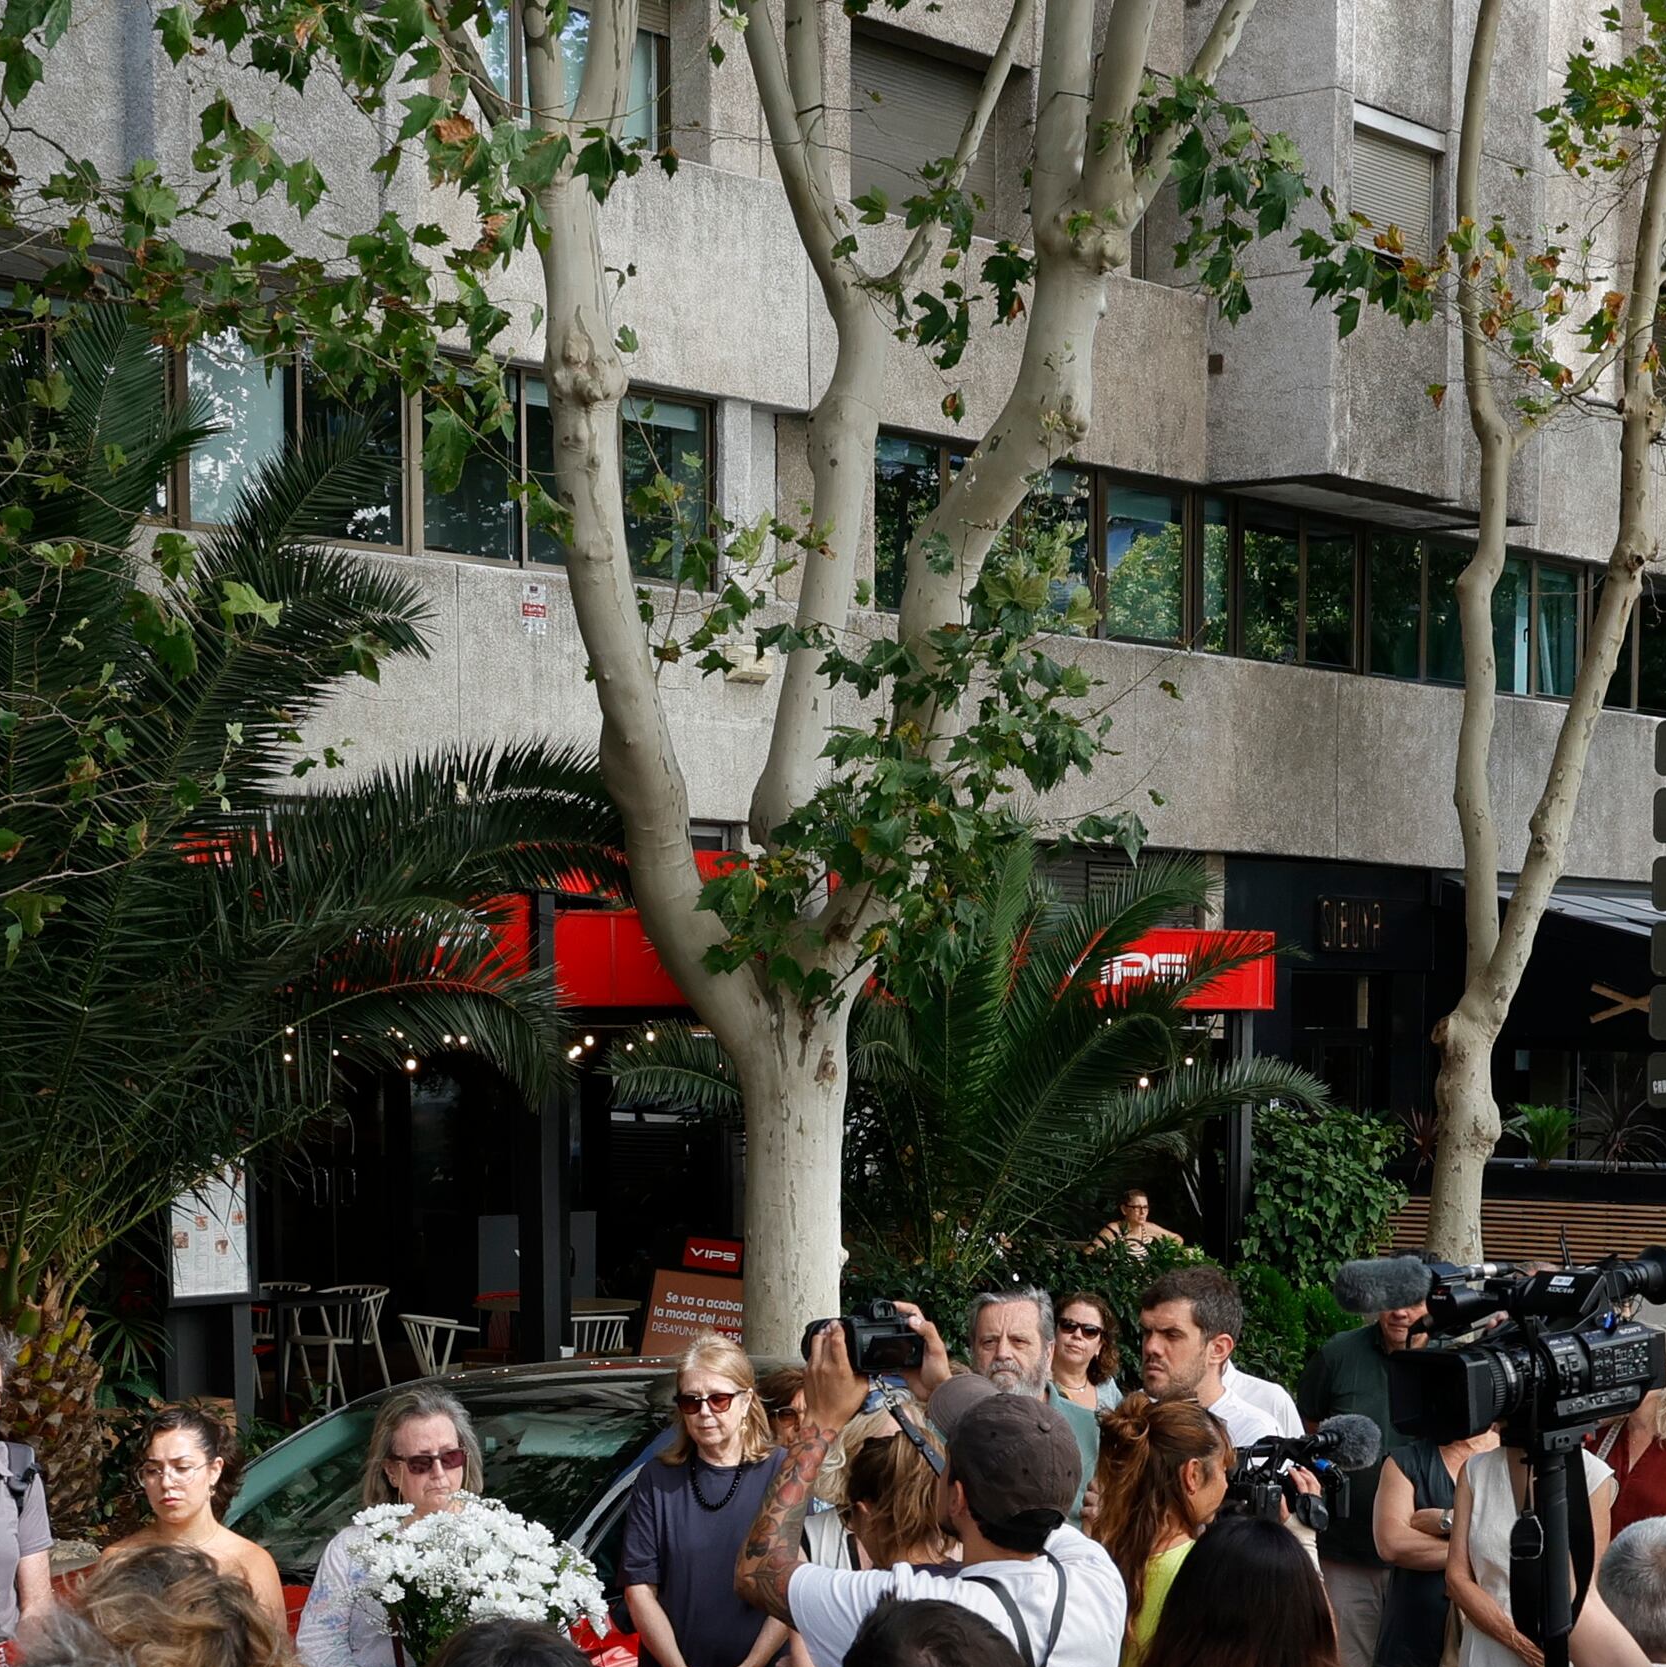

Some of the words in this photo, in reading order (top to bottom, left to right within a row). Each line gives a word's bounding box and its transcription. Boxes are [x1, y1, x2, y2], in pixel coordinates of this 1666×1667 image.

[690, 1247, 736, 1262] VIPS
[665, 1291, 679, 1303] Se
[681, 1295, 695, 1305] va
[696, 1298, 704, 1307] a
[653, 1305, 664, 1317] la
[665, 1308, 697, 1322] moda
[698, 1312, 716, 1325] del
[716, 1315, 743, 1328] AYUN
